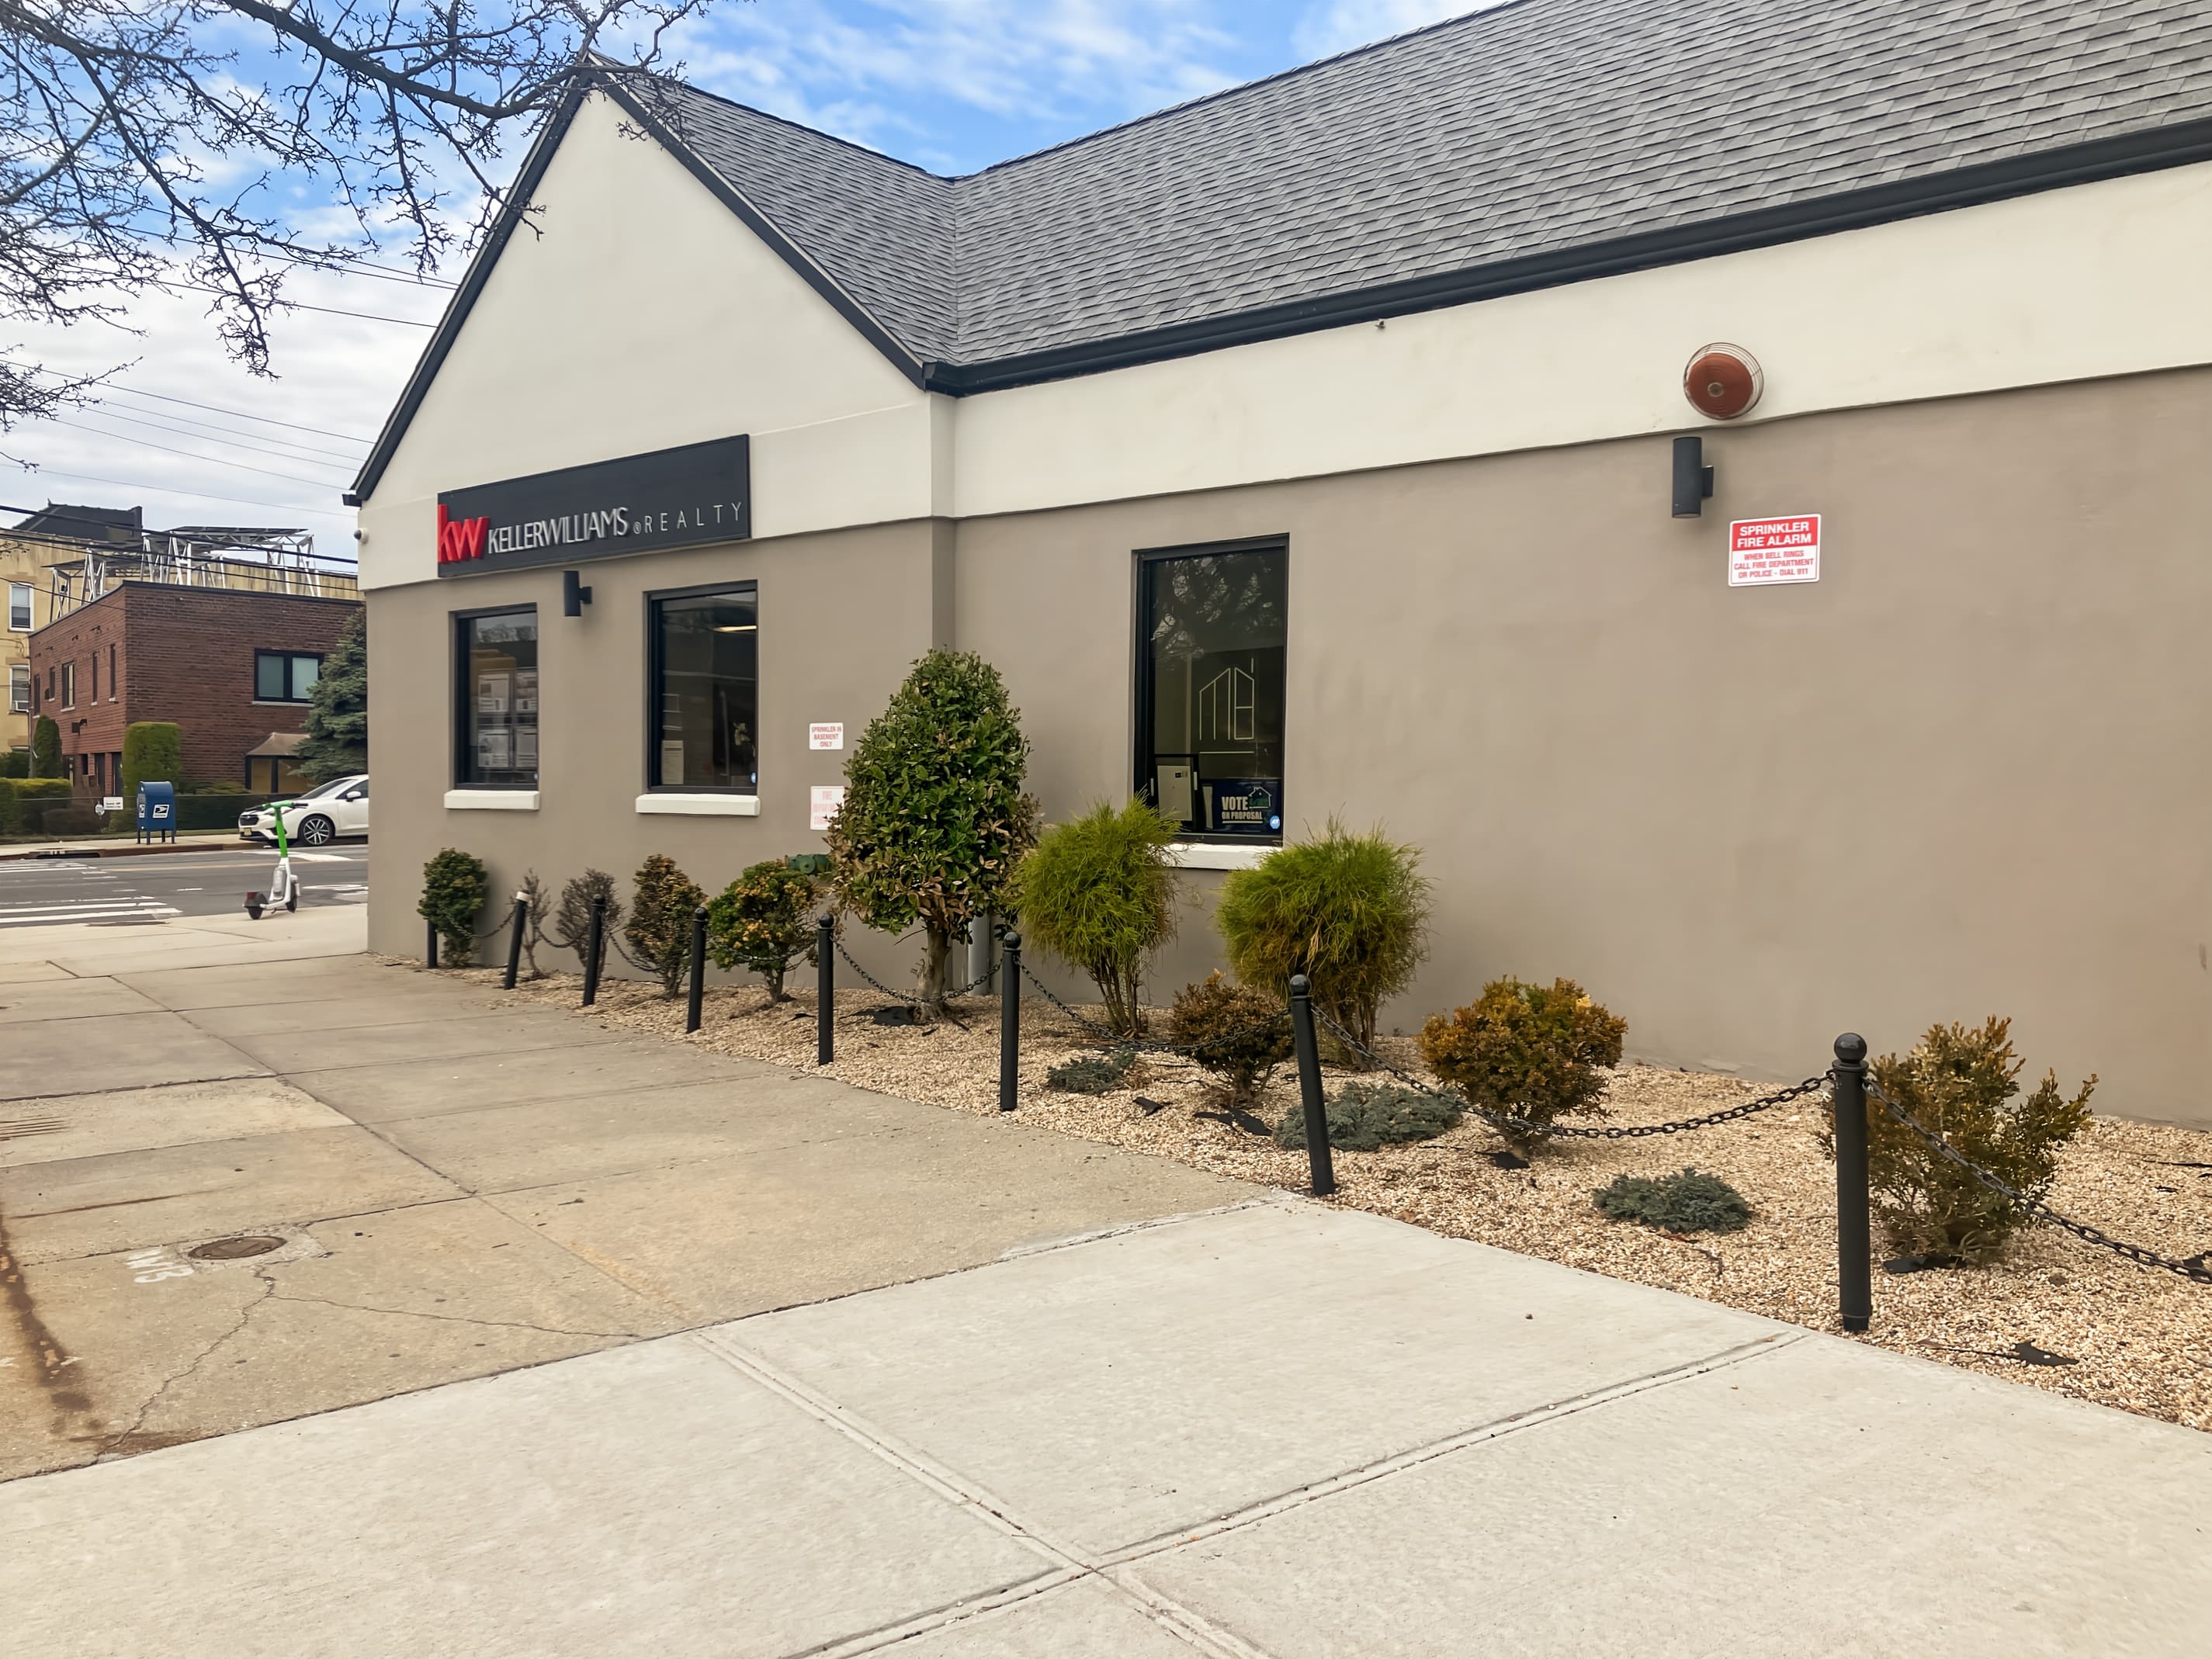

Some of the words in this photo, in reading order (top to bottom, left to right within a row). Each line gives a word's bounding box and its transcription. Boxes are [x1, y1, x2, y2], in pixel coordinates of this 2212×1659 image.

[643, 502, 742, 534] REALTY
[1739, 521, 1809, 536] SPRINKLER
[1737, 537, 1764, 548] FIRE
[1766, 533, 1812, 545] ALARM
[1769, 558, 1814, 568] DEPARTMENT
[1749, 570, 1772, 578] POLICE
[1222, 796, 1249, 811] VOTE
[1222, 811, 1229, 819] ON
[1231, 811, 1263, 819] PROPOSAL
